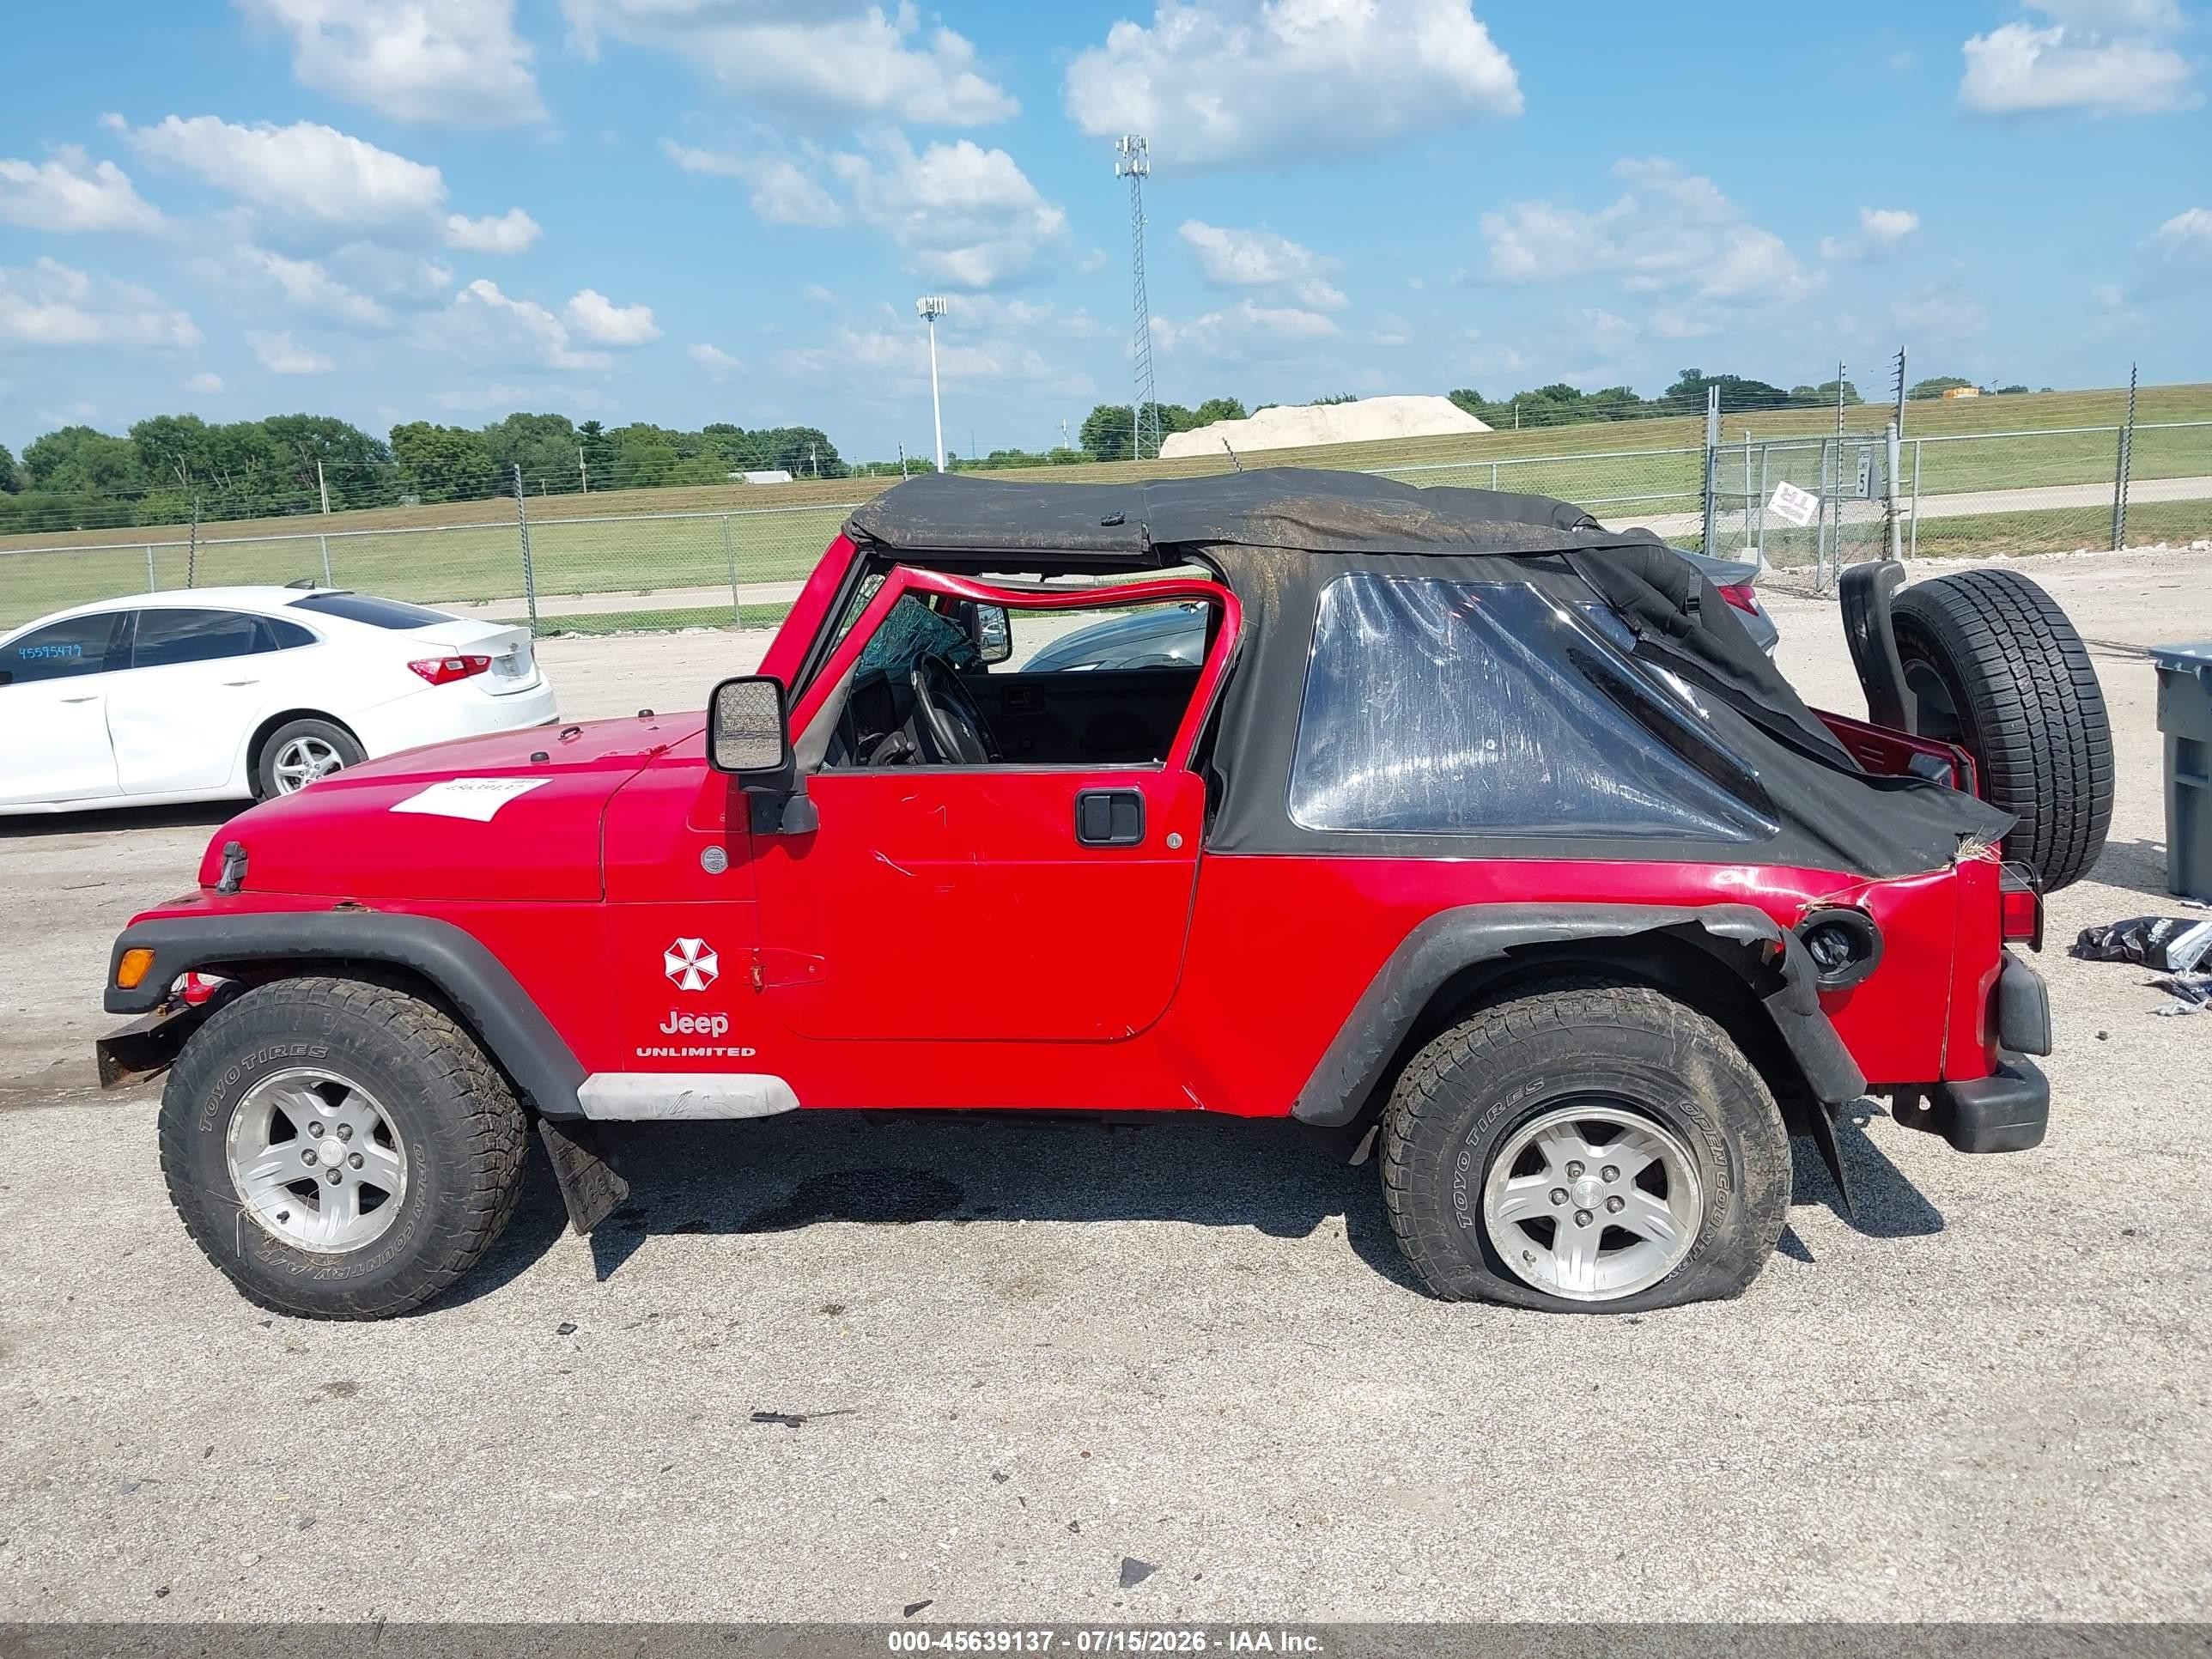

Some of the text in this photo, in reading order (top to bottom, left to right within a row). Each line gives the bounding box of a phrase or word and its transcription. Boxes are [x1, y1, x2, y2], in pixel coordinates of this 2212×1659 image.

[1859, 473, 1865, 493] 5
[19, 644, 82, 659] 45595479
[659, 1011, 729, 1037] Jeep
[636, 1047, 756, 1057] UNLIMITED
[198, 1043, 330, 1133] TOYO TIRES
[1453, 1077, 1546, 1229] TOYO TIRES
[412, 1143, 428, 1219] OPEN
[575, 1170, 617, 1213] Jeep
[1662, 1100, 1730, 1285] OPEN COUNTRY
[313, 1222, 415, 1281] COUNTRY
